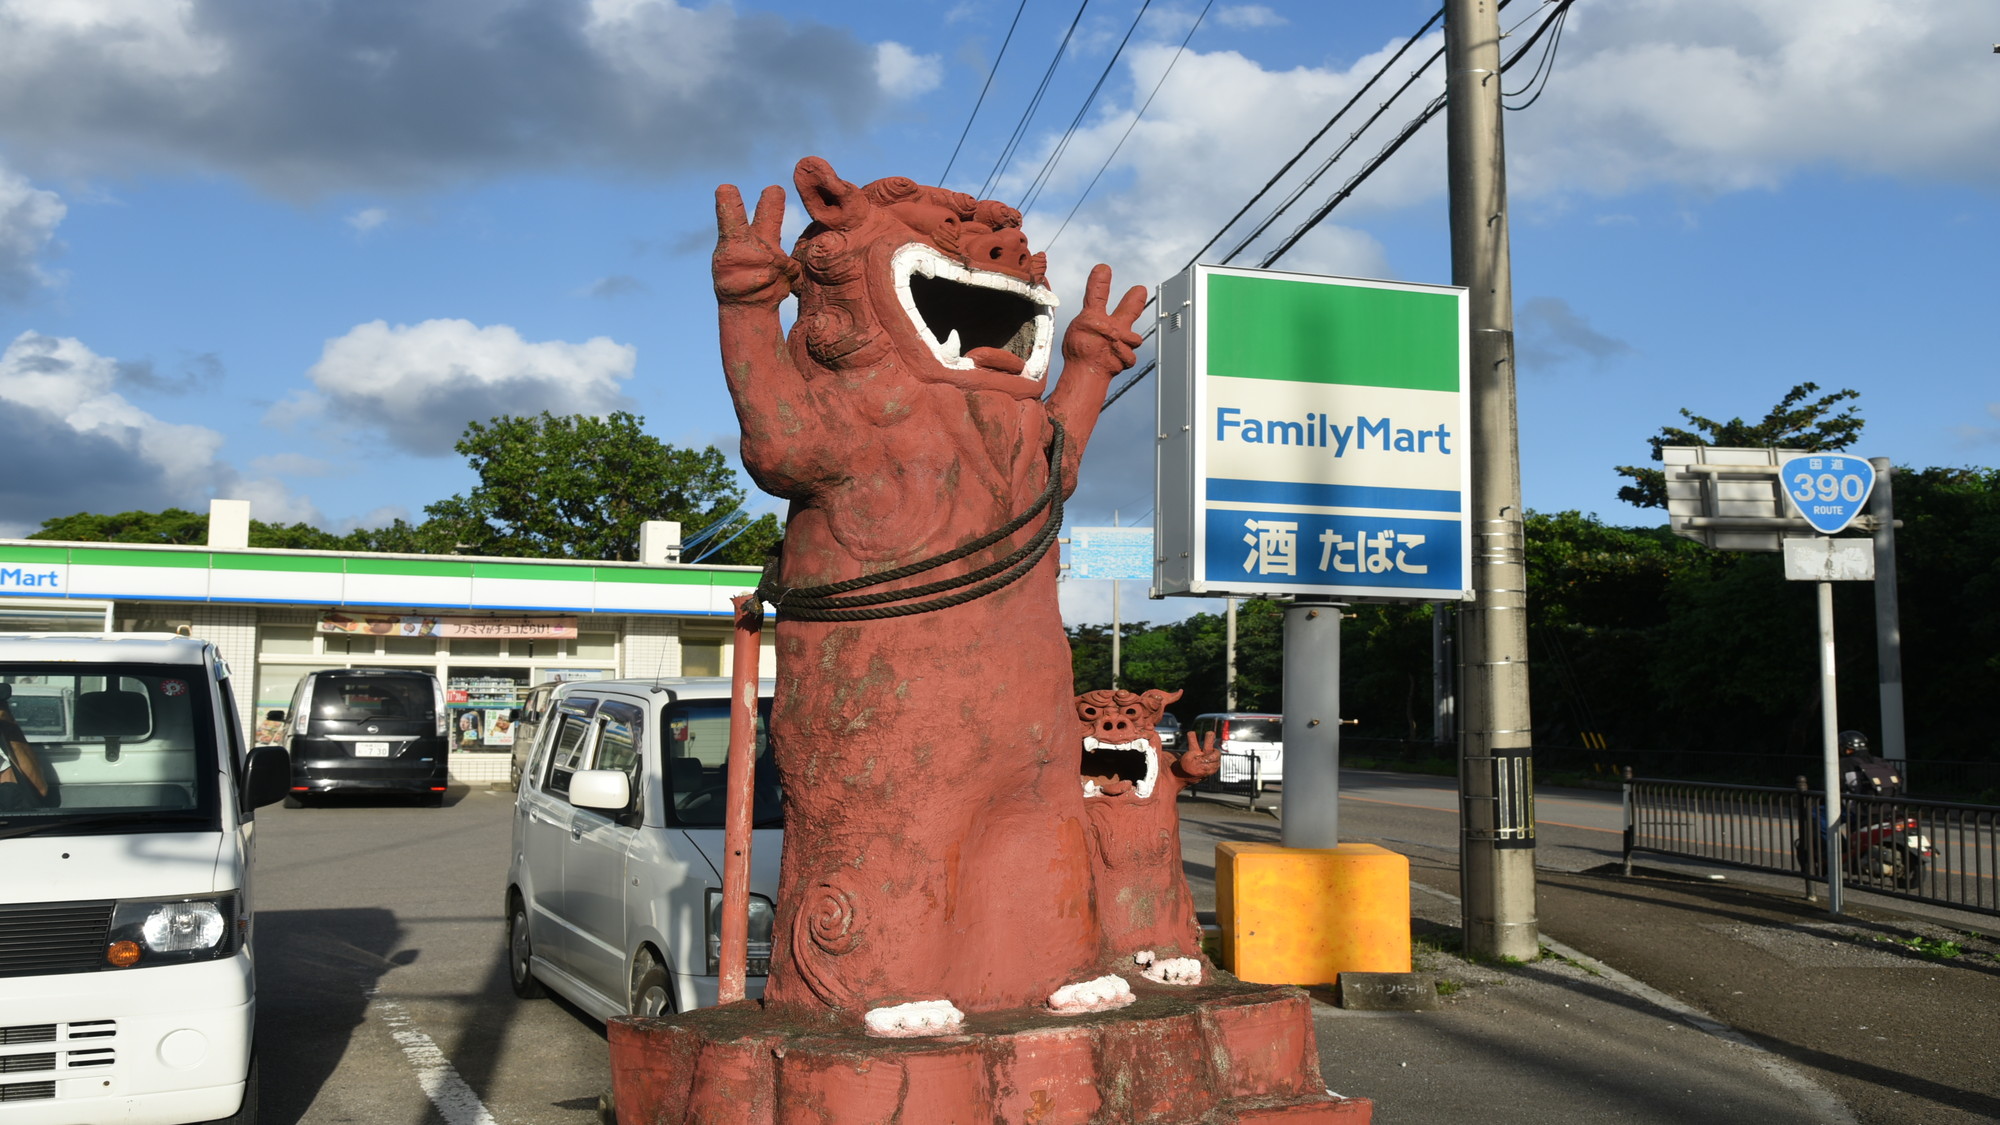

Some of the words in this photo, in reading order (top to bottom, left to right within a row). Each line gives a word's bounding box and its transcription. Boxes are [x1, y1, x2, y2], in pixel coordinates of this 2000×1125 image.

[1216, 406, 1452, 458] FamilyMart
[1809, 458, 1845, 470] 国道
[1793, 473, 1864, 503] 390
[1813, 505, 1844, 515] ROUTE
[1243, 518, 1299, 576] 酒
[1318, 528, 1429, 575] たばこ
[0, 568, 59, 587] Mart
